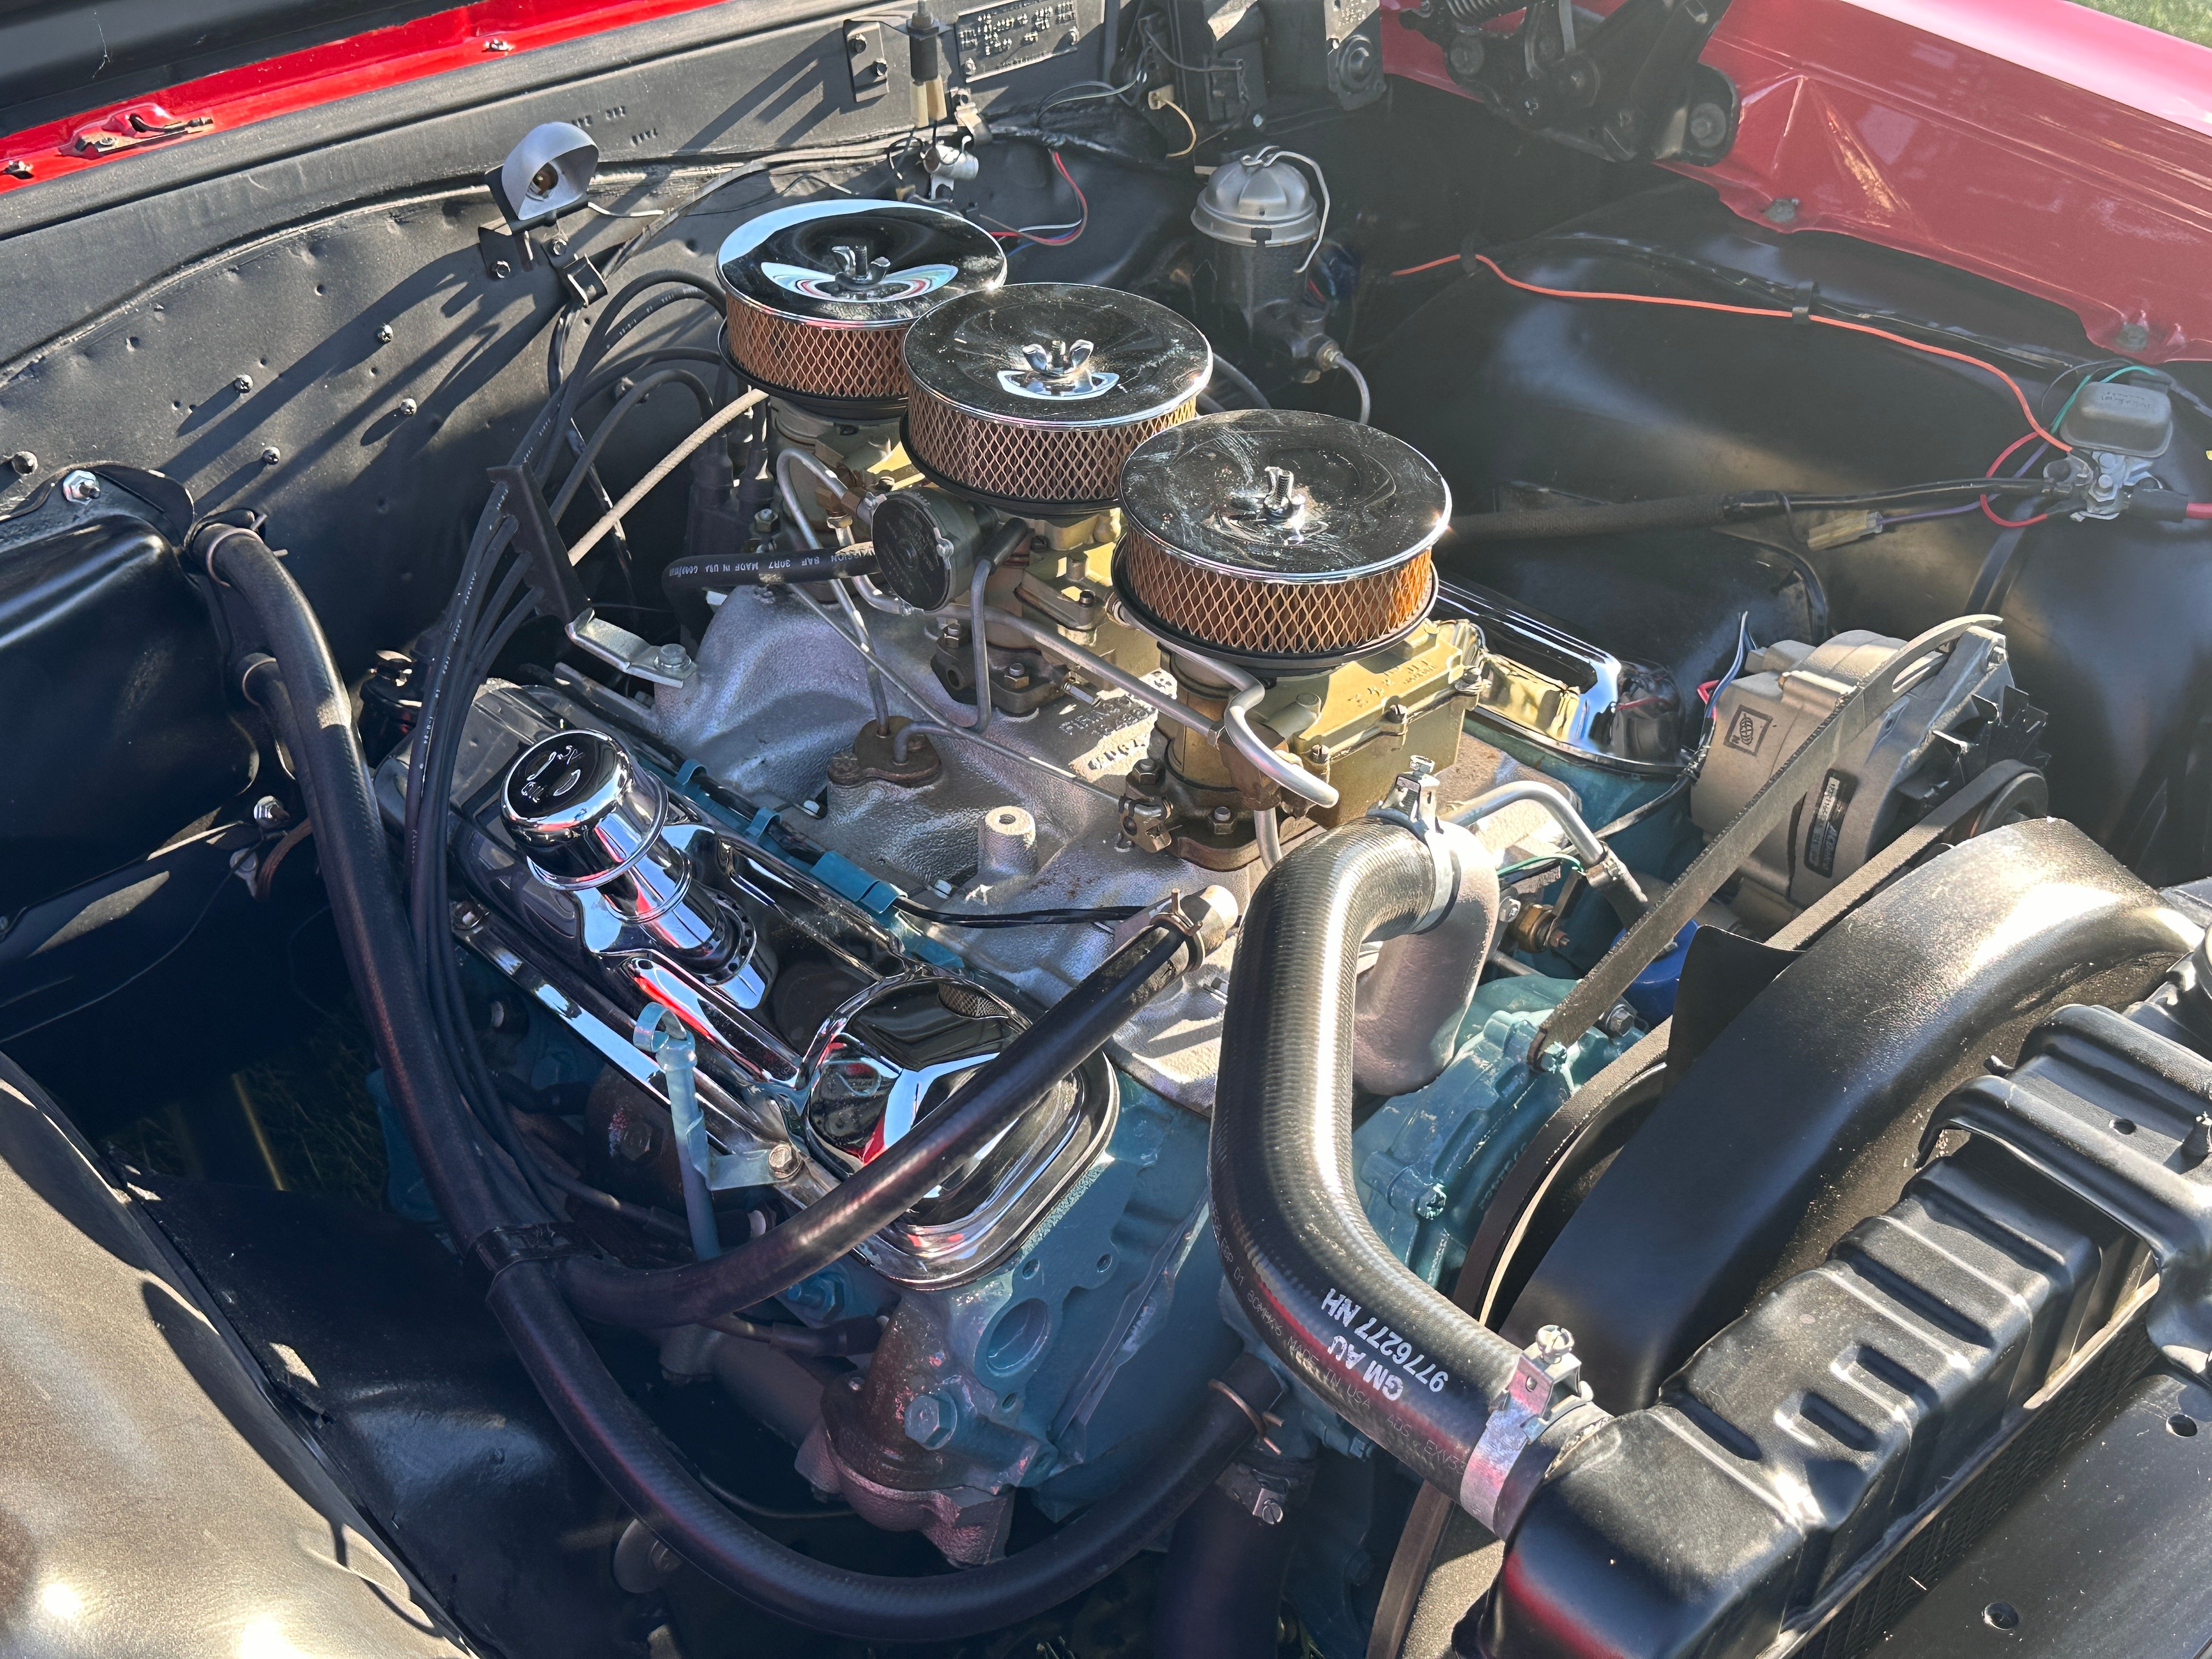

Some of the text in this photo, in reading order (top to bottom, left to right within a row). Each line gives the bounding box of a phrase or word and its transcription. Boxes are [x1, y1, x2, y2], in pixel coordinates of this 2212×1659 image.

[723, 563, 731, 572] IN
[1321, 1288, 1449, 1392] 9776277 NH
[1324, 1368, 1342, 1388] IN
[1346, 1384, 1370, 1409] USA
[1327, 1335, 1404, 1401] GM AU
